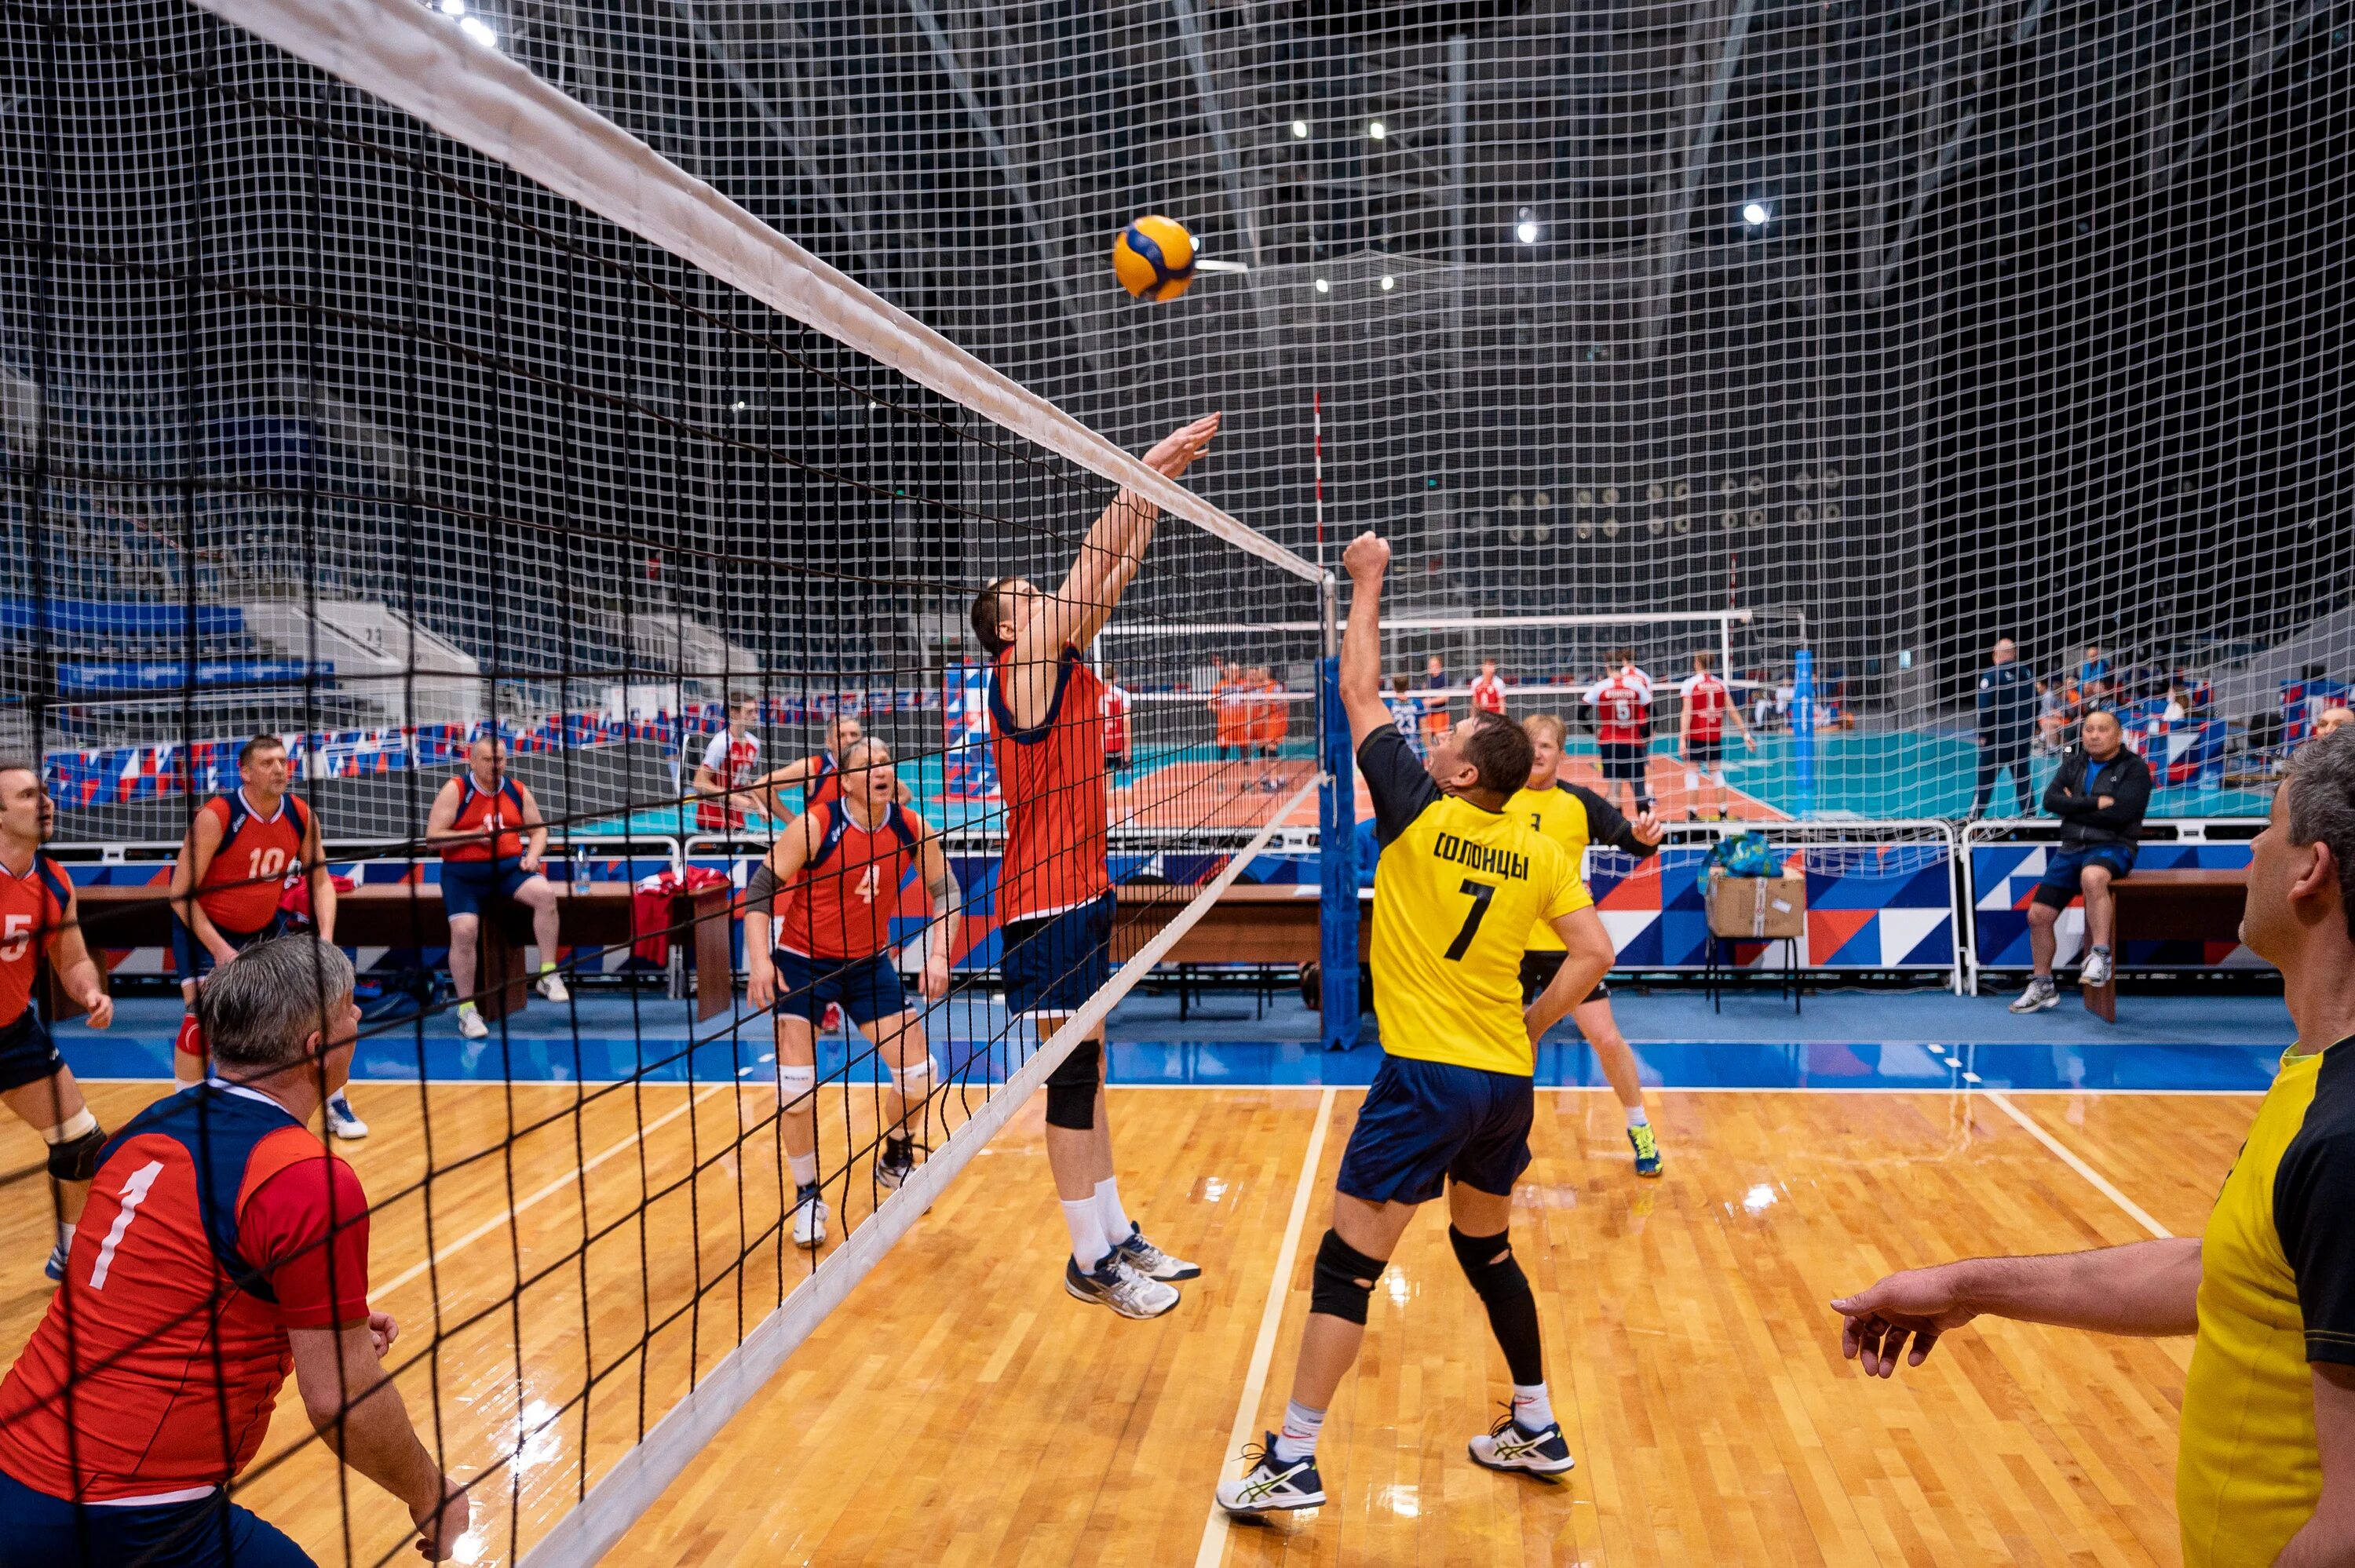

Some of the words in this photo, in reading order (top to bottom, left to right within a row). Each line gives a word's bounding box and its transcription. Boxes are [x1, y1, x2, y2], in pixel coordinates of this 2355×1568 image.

[248, 847, 285, 882] 10
[1433, 832, 1529, 881] СОЛОНЦЫ
[854, 864, 880, 904] 4
[0, 914, 31, 962] 5
[1444, 878, 1495, 962] 7
[89, 1159, 165, 1291] 1
